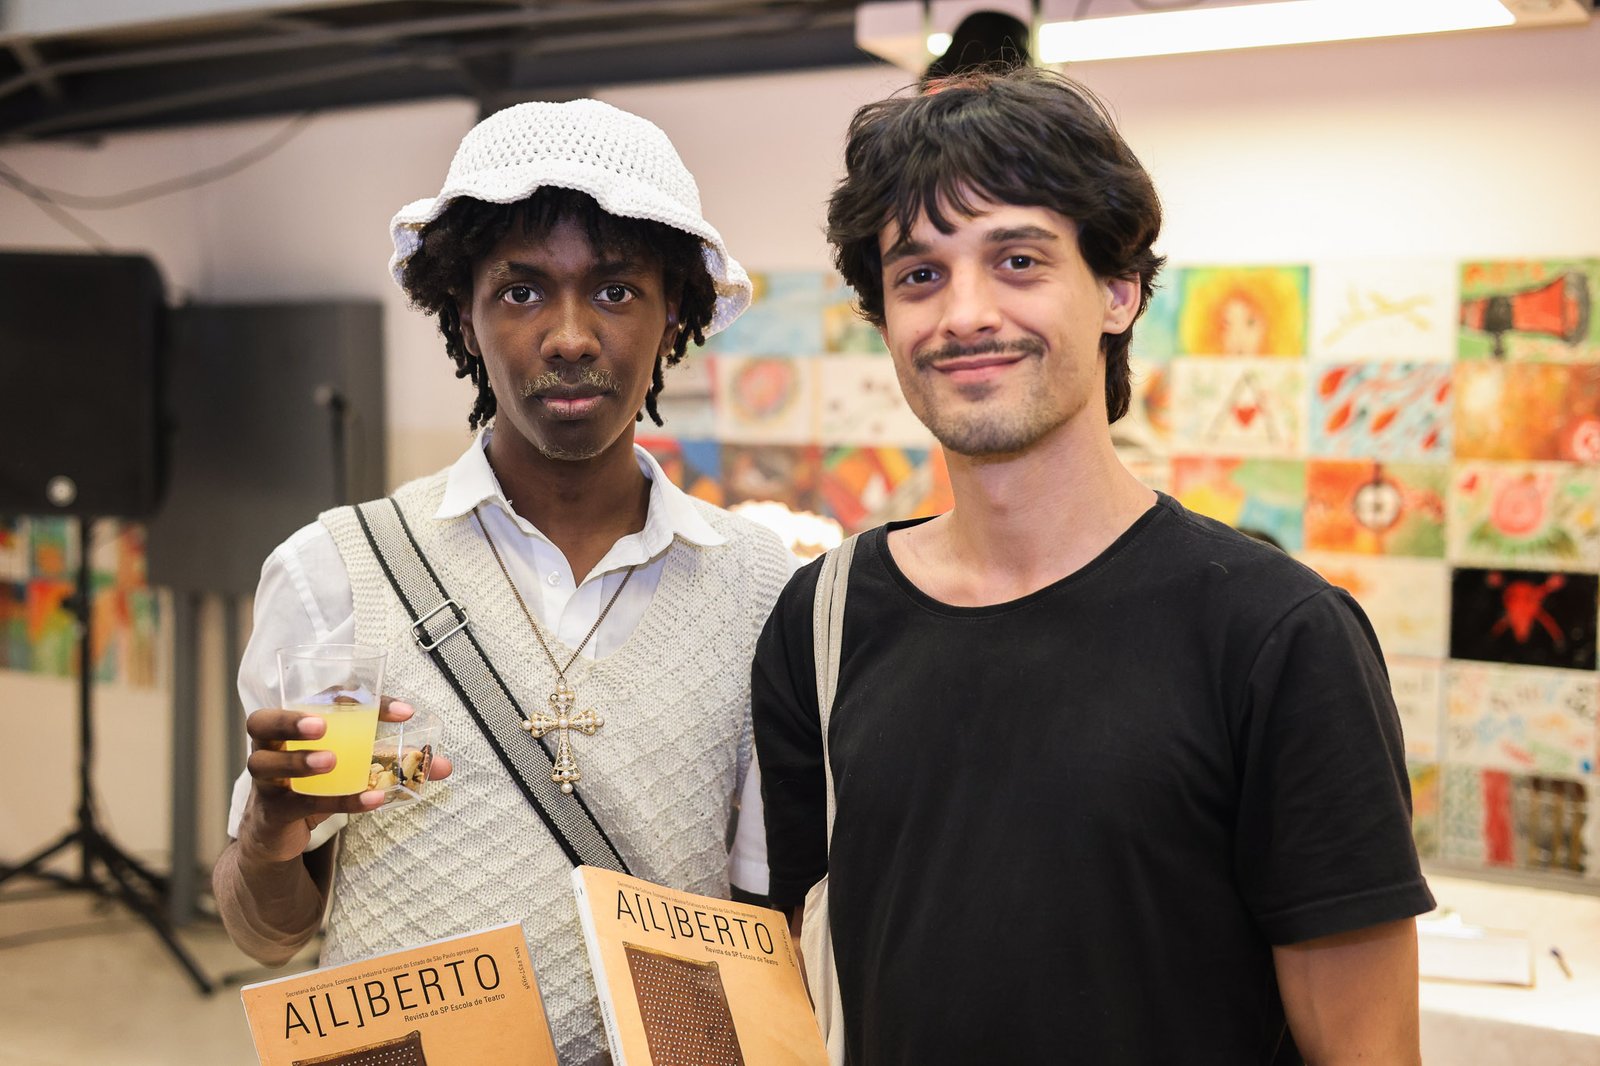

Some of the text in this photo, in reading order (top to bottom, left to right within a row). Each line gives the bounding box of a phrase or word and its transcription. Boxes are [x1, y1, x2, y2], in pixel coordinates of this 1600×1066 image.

[617, 889, 774, 955] A[L]BERTO
[285, 988, 310, 998] Secretaria
[335, 976, 358, 986] Economia
[382, 964, 403, 974] Criativas
[410, 959, 426, 968] Estado
[442, 952, 456, 960] Paulo
[456, 946, 480, 957] apresenta
[285, 953, 501, 1039] A[L]BERTO
[404, 993, 506, 1022] Revista da SP Escola de Teatro
